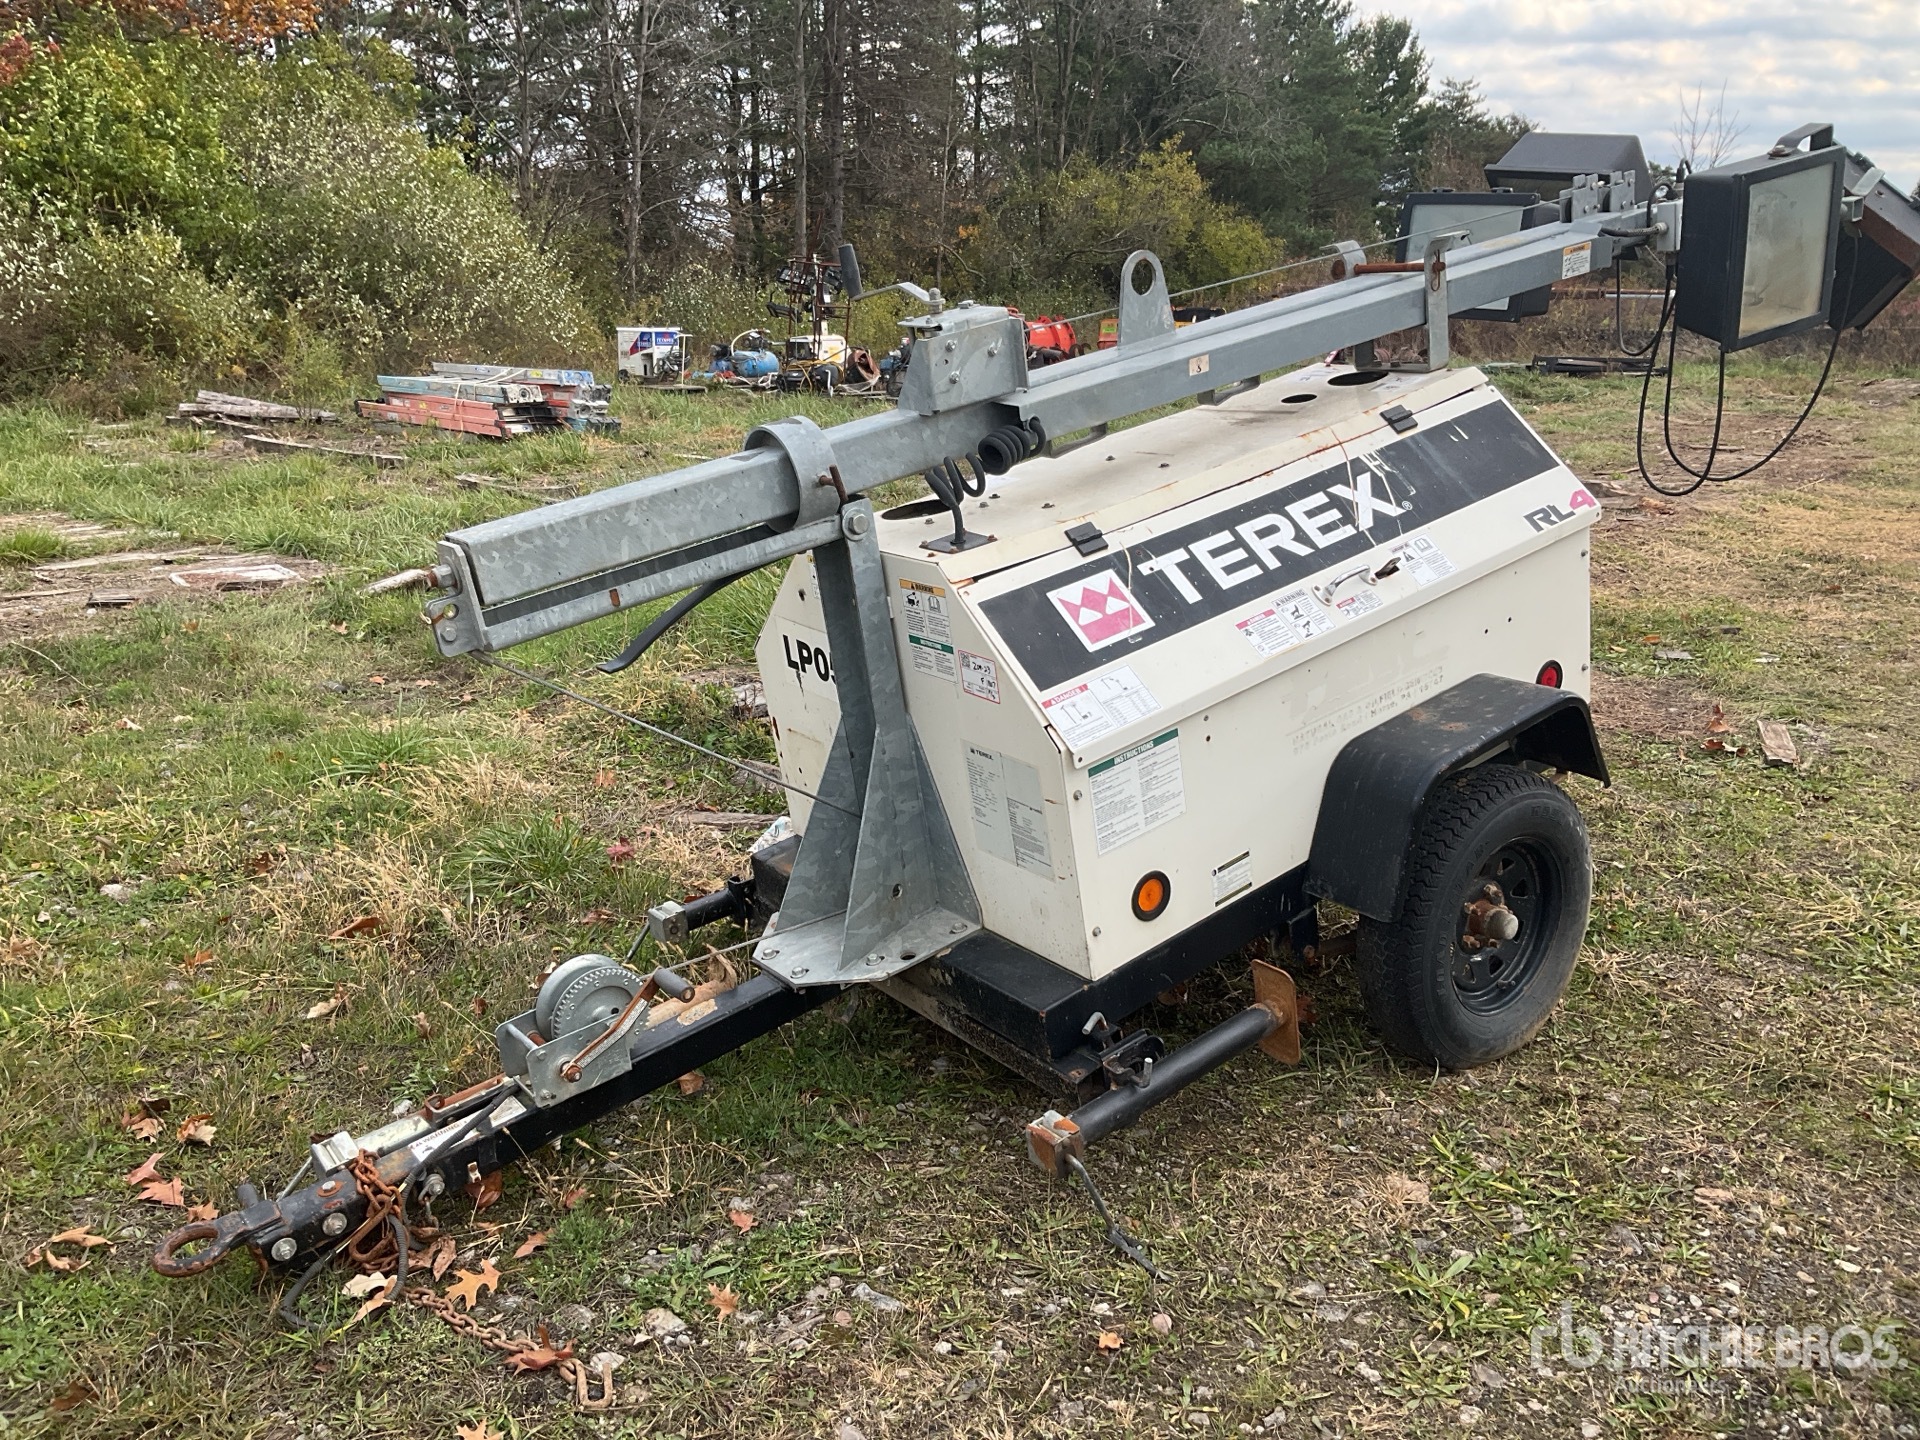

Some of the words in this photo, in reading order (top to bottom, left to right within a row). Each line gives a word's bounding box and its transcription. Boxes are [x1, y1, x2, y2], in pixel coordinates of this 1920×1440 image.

[1523, 488, 1597, 533] RL4
[1136, 471, 1408, 605] TEREX
[1113, 740, 1154, 766] INSTRUCTIONS
